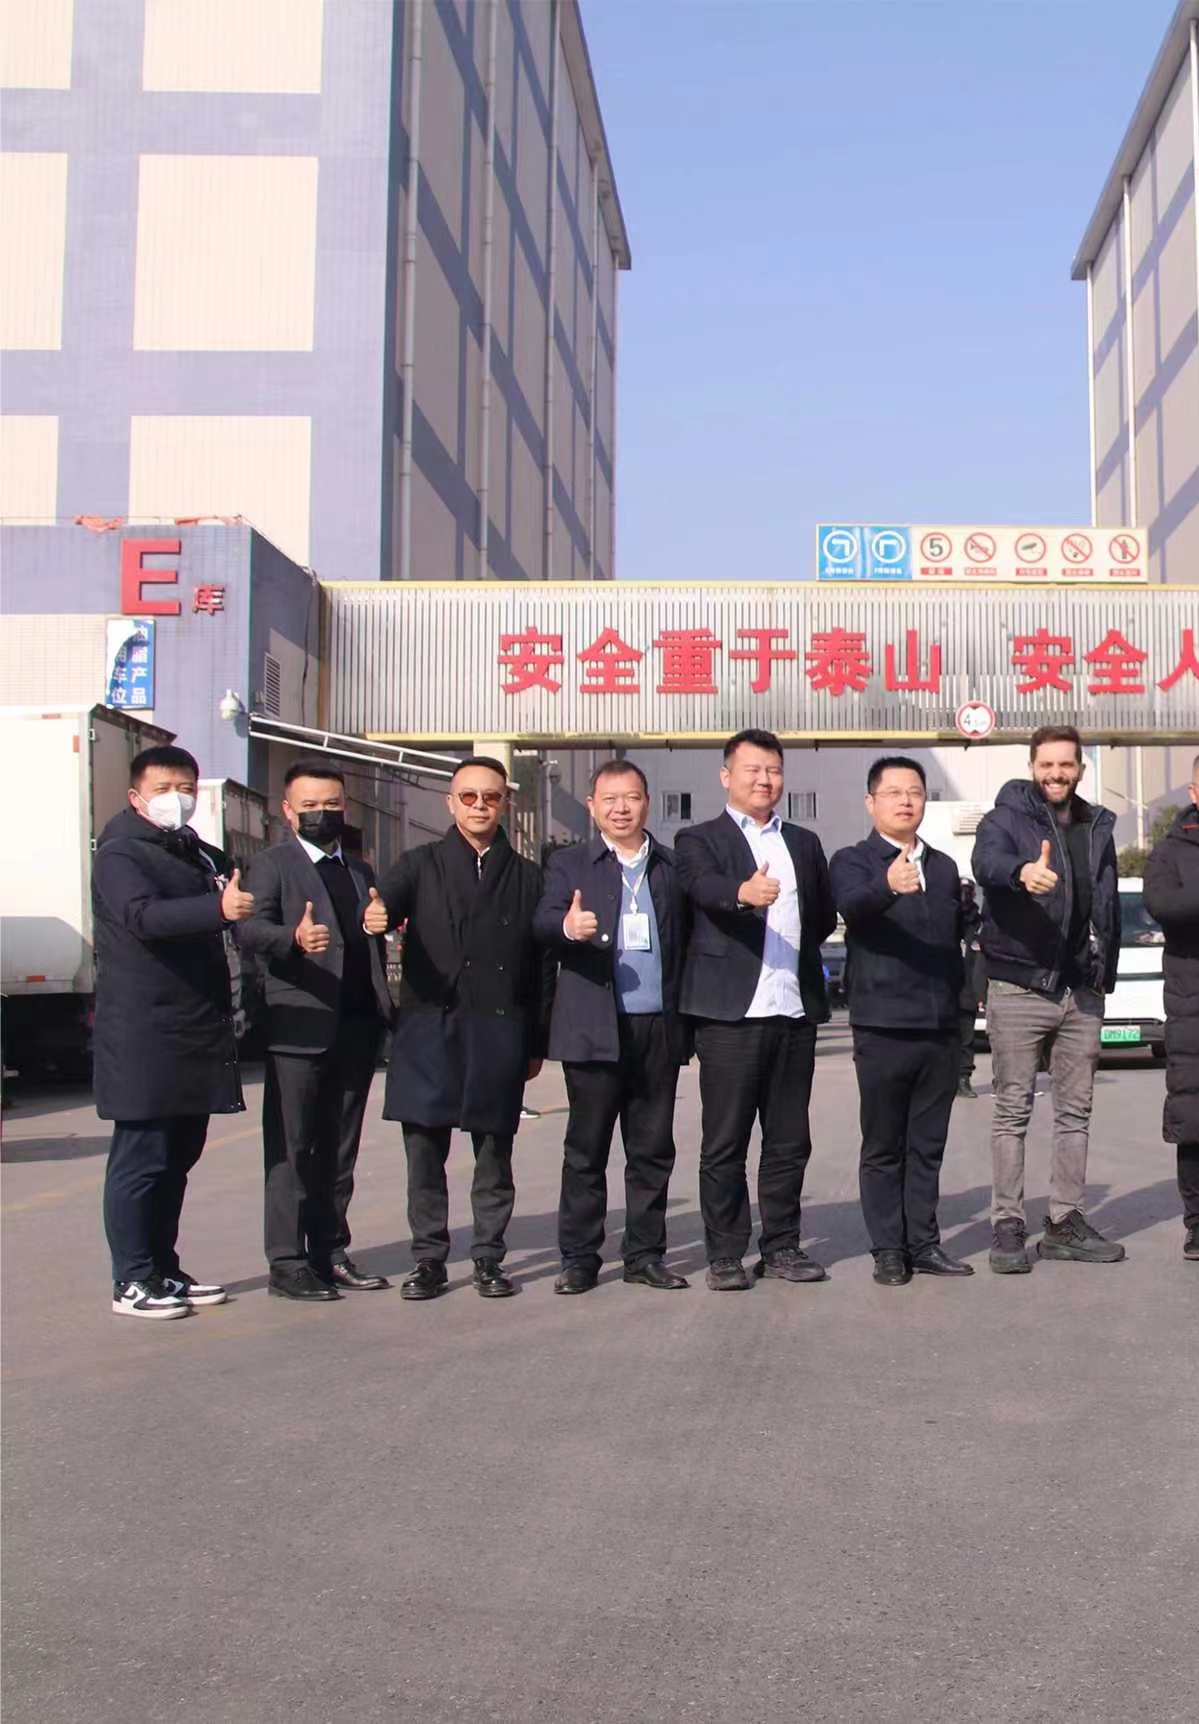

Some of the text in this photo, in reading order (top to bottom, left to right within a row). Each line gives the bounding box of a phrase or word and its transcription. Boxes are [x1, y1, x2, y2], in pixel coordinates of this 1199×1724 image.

[121, 538, 225, 616] E 库
[929, 537, 944, 558] 5
[497, 626, 942, 696] 安全重于泰山
